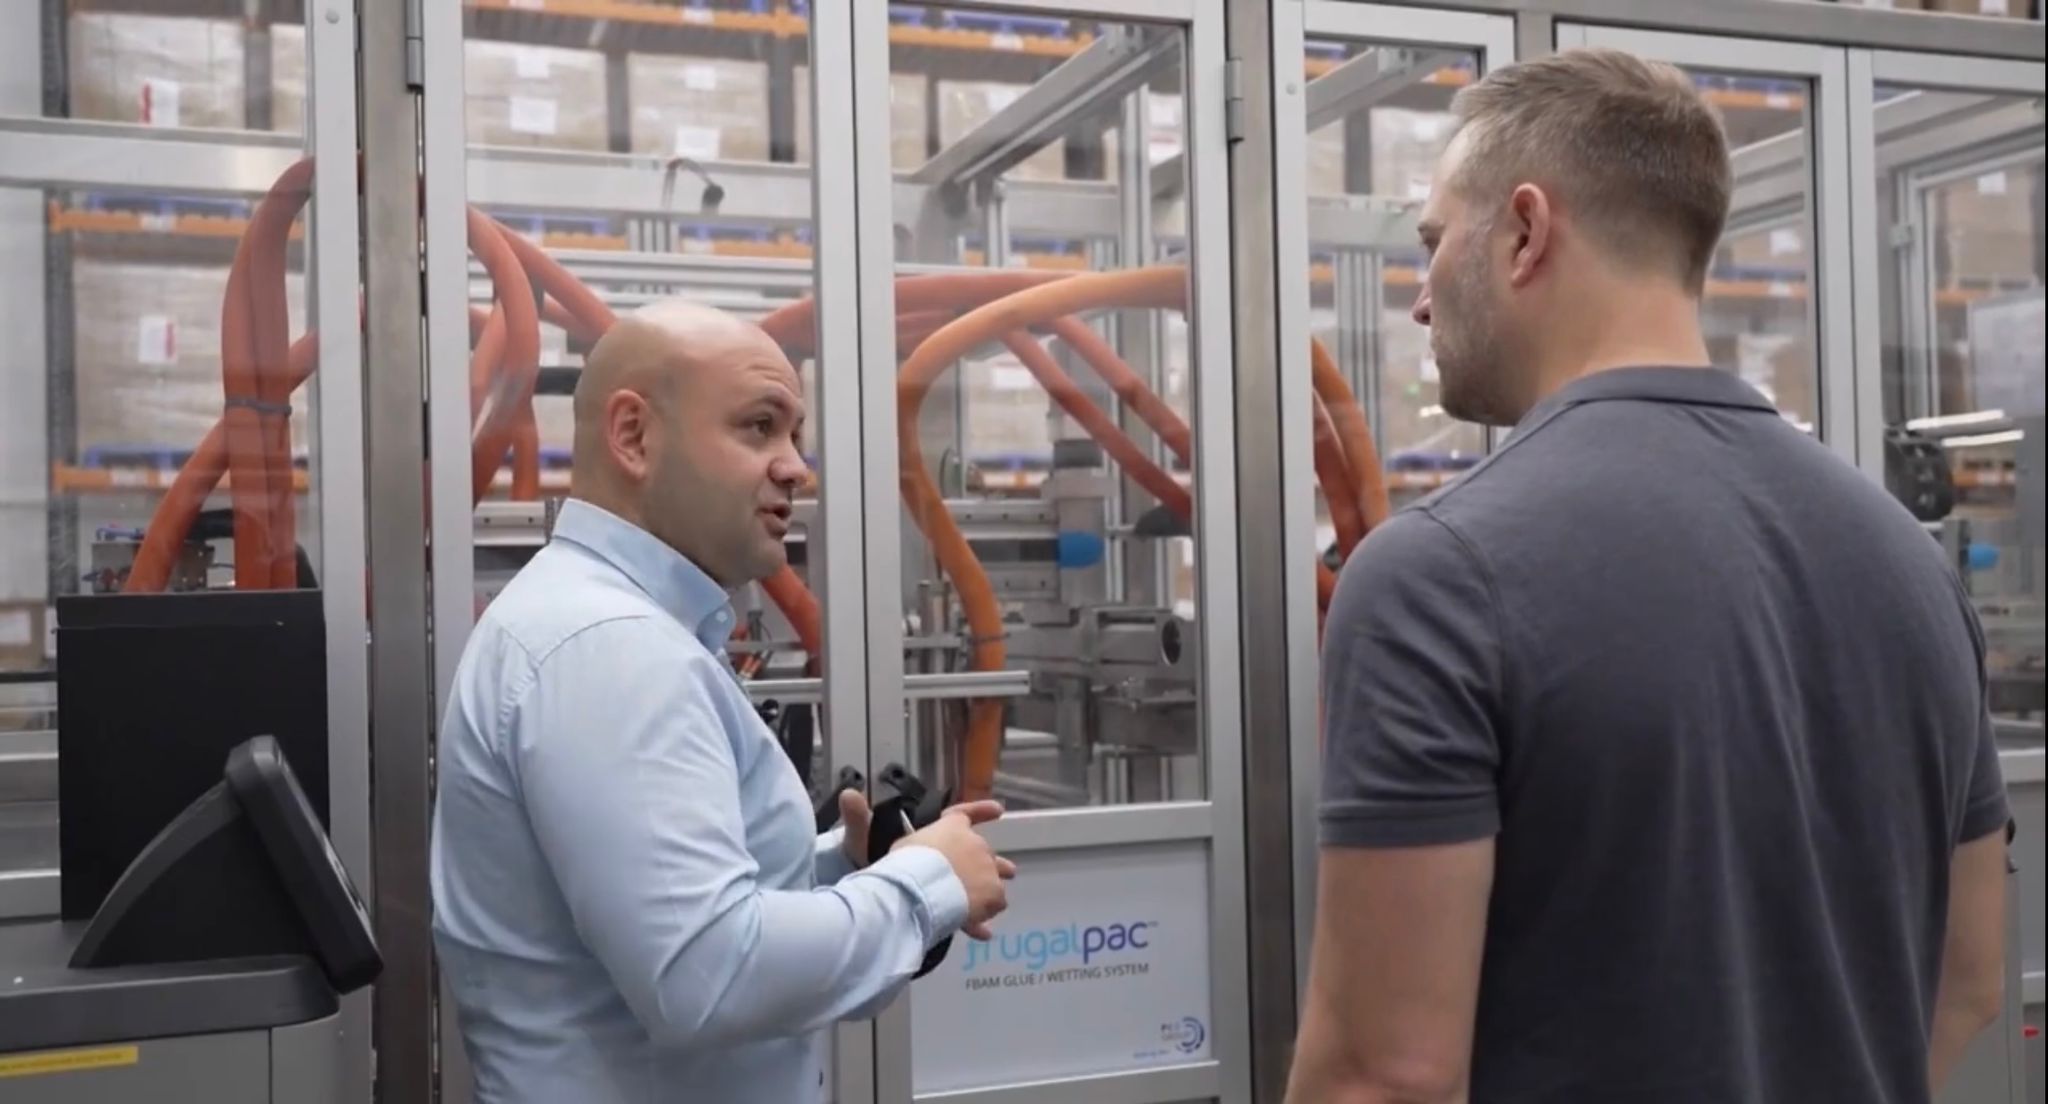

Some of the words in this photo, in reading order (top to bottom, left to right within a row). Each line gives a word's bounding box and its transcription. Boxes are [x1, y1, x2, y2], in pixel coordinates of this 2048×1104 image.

[966, 976, 1000, 990] FBAM
[1003, 973, 1034, 987] GLUE
[1047, 967, 1101, 983] WETTING
[1104, 963, 1149, 977] SYSTEM
